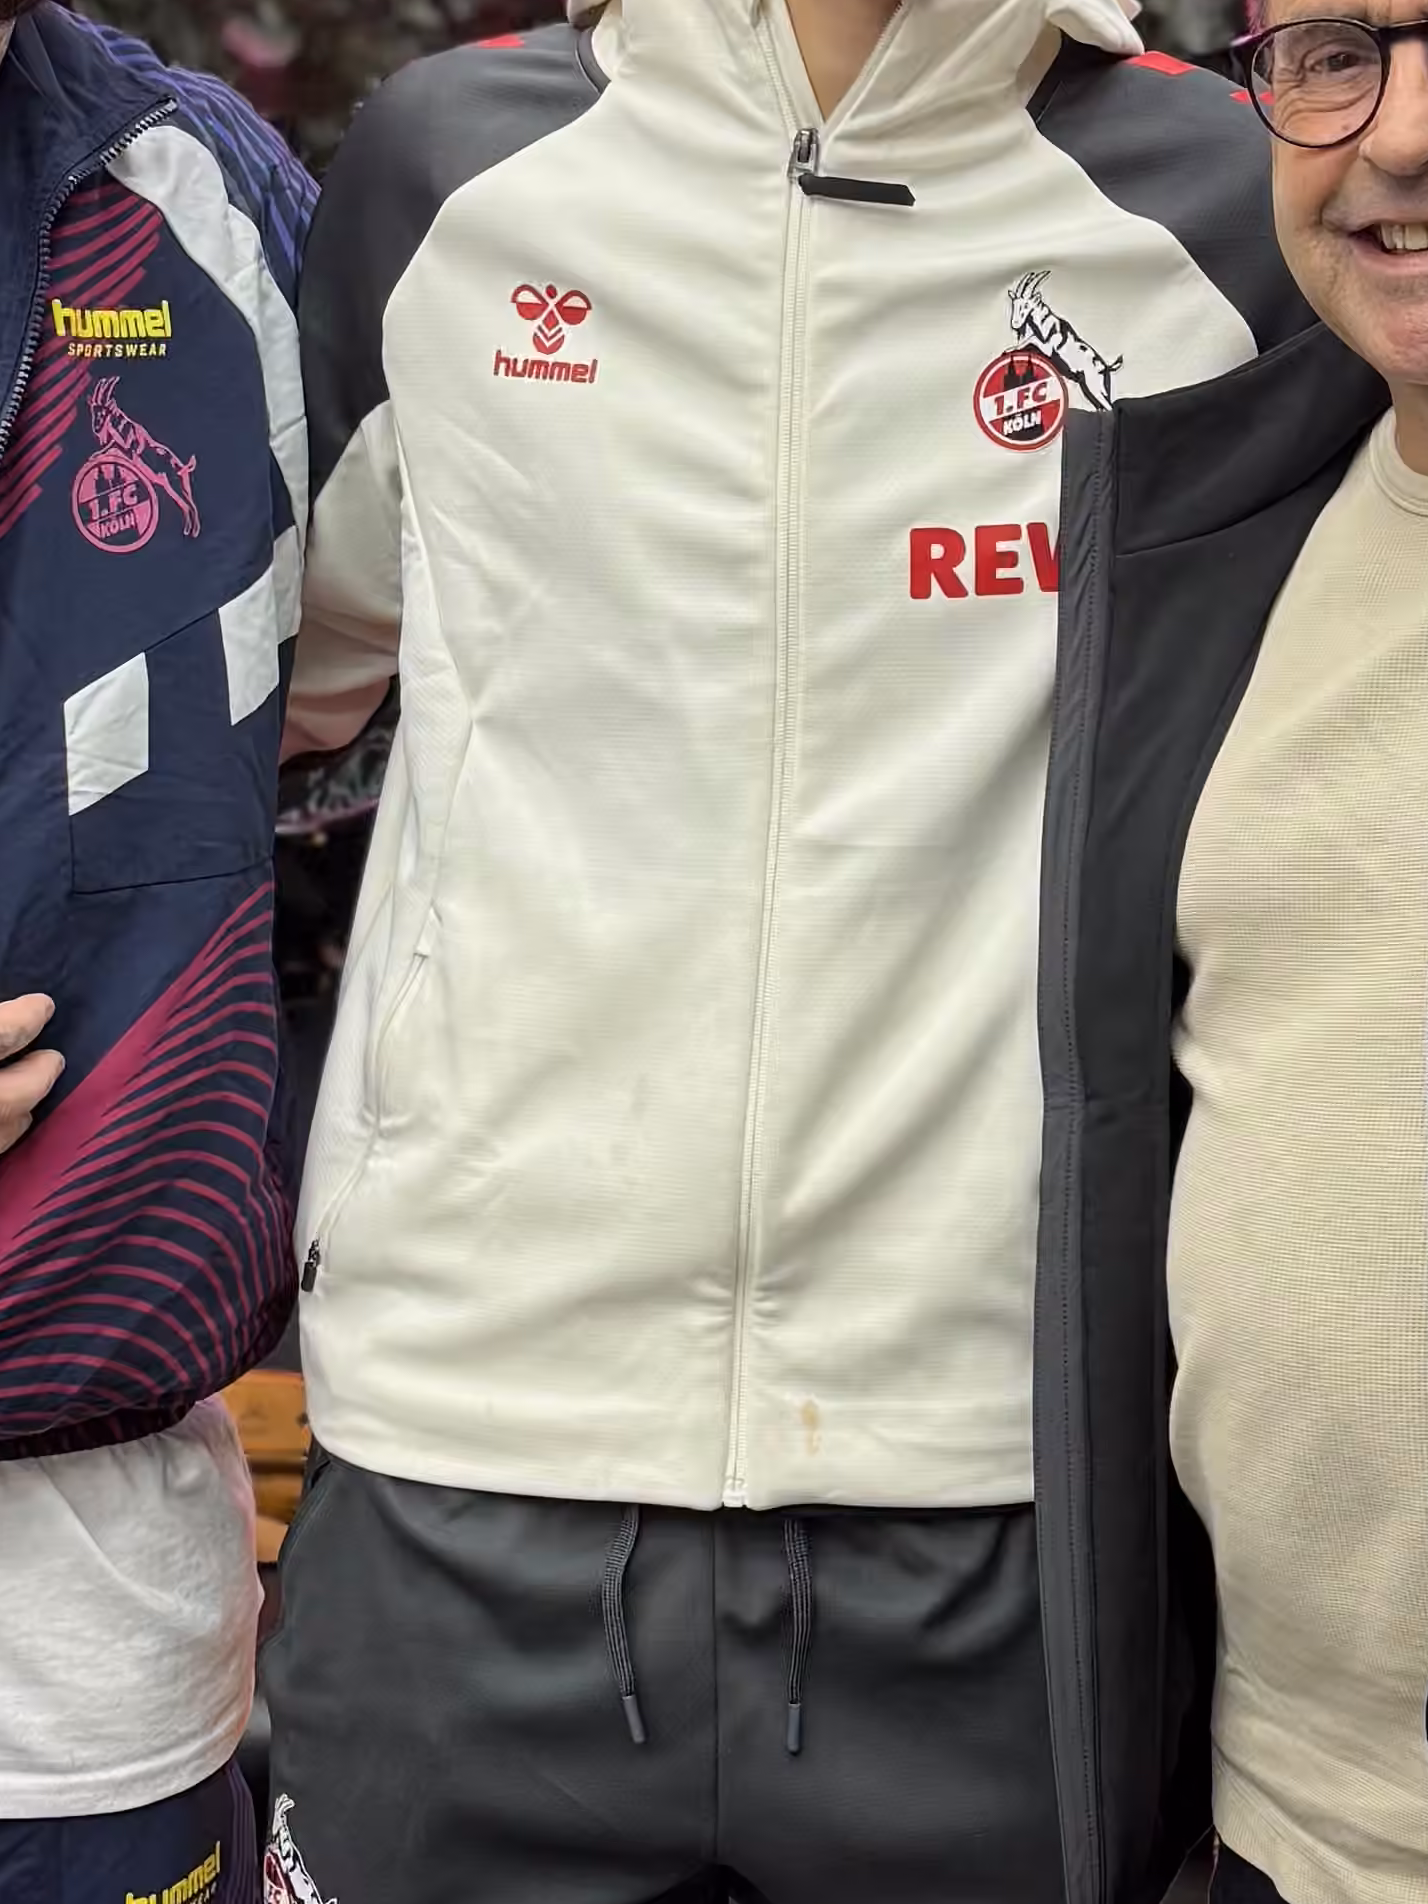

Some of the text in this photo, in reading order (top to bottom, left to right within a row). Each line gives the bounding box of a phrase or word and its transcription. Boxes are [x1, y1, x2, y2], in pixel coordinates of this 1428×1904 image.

[52, 298, 172, 337] hummel
[67, 342, 167, 358] SPORTSWEAR
[494, 349, 598, 385] hummel
[1003, 409, 1042, 436] KÖLN
